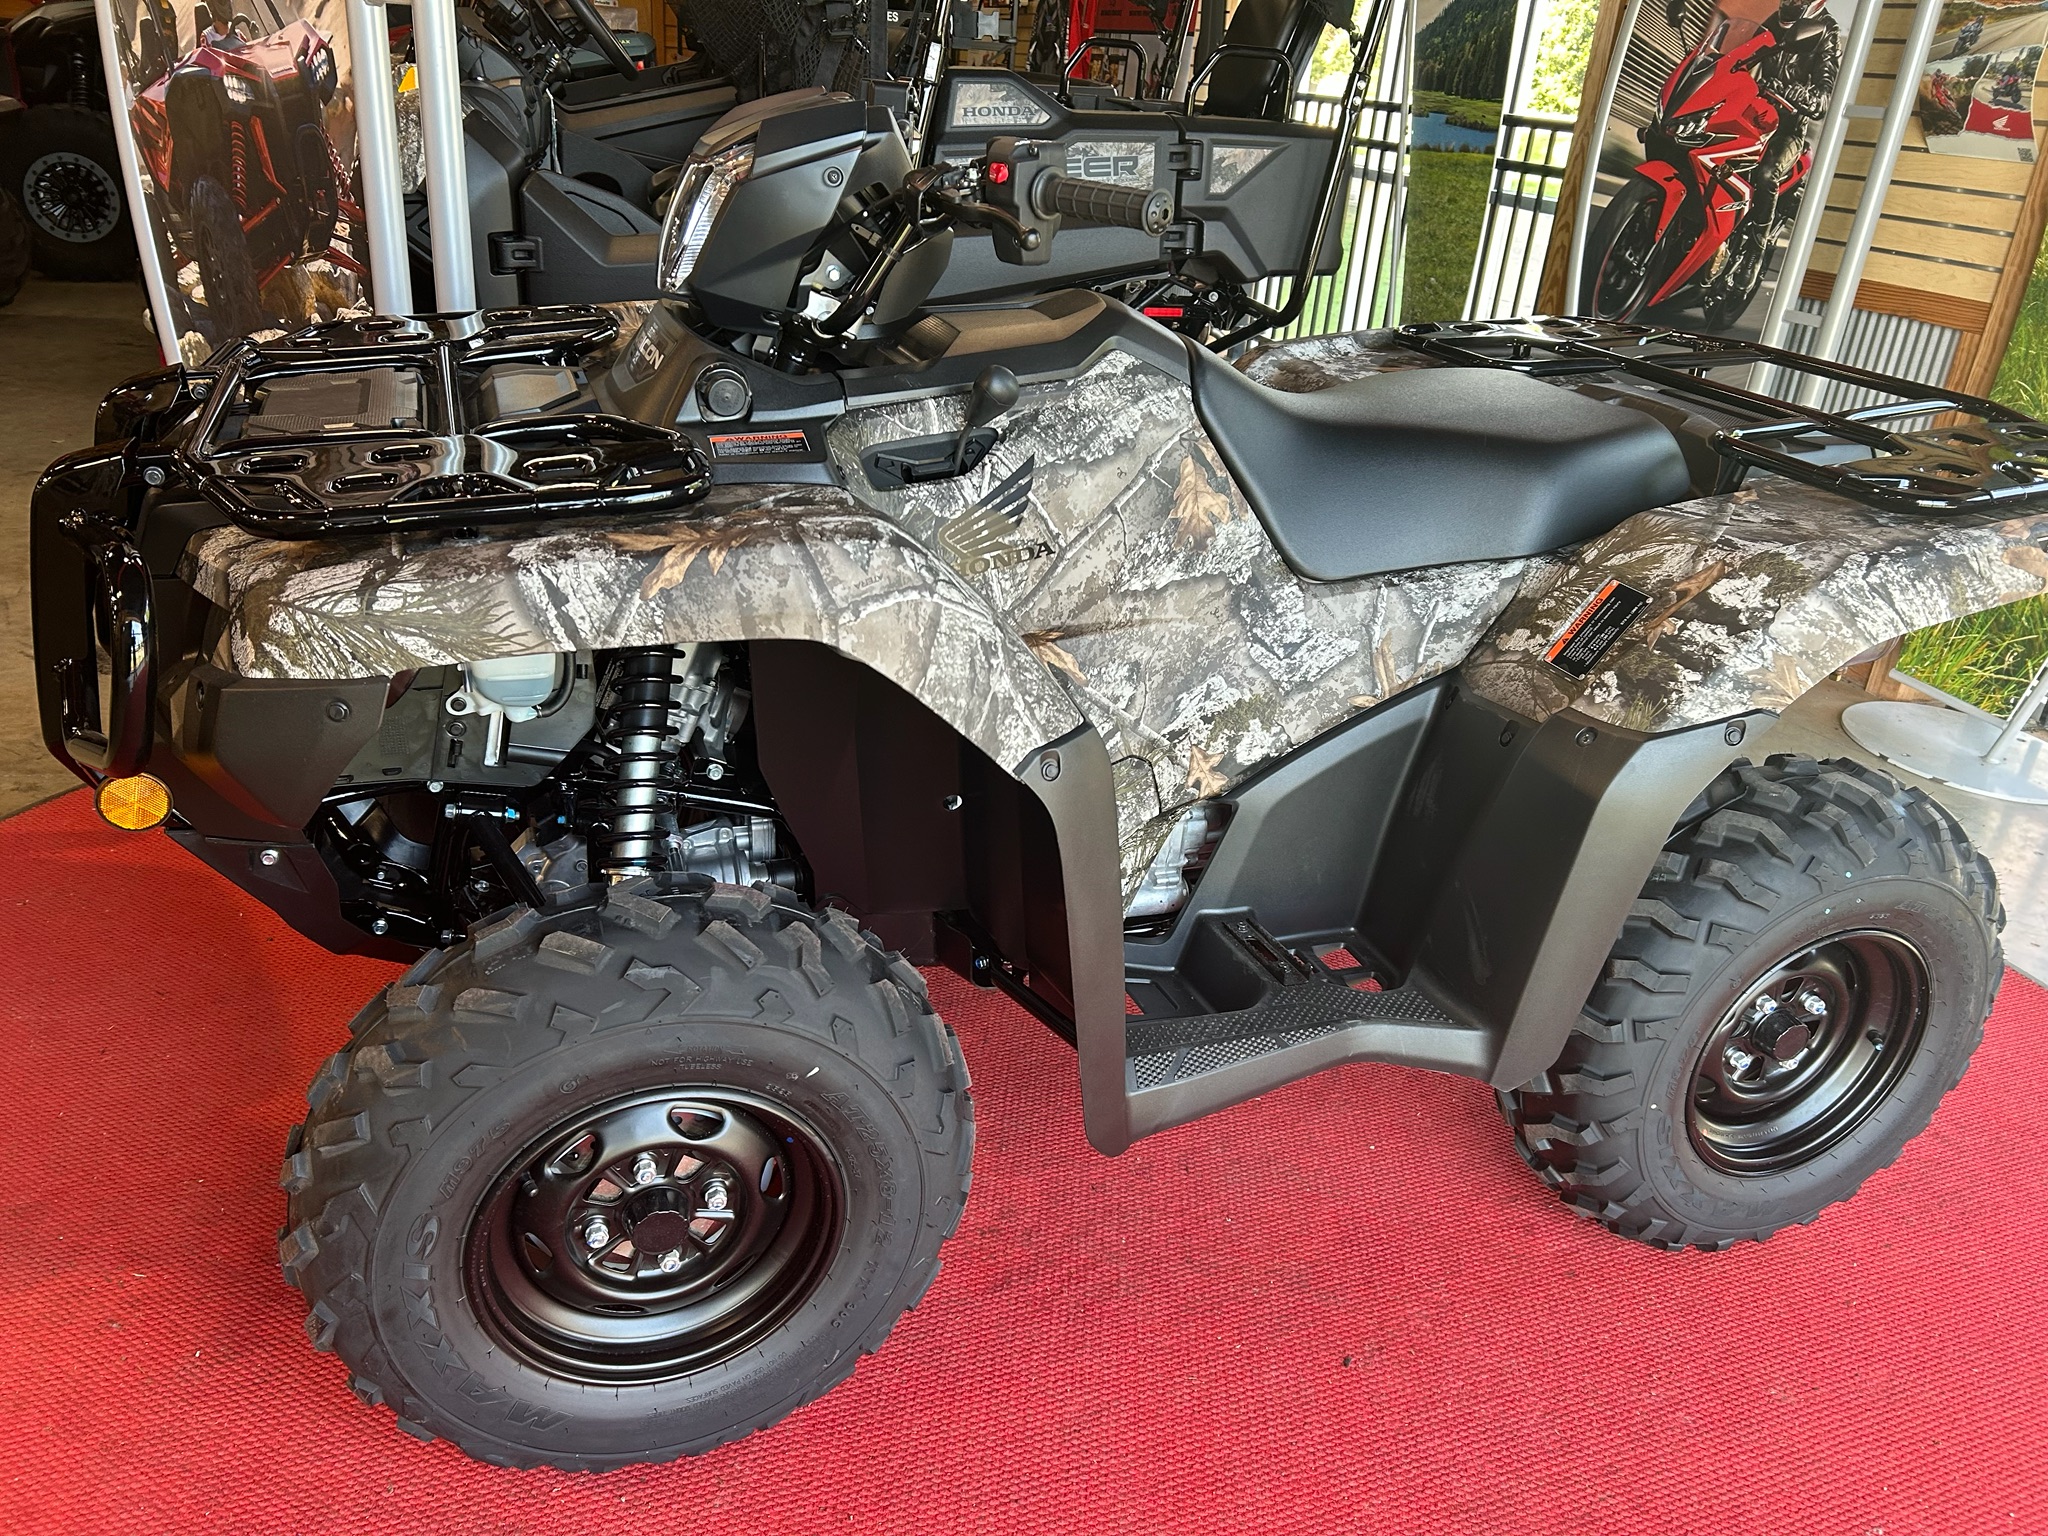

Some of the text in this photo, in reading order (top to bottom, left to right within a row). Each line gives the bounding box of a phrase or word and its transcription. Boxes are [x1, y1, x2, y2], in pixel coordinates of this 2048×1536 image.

[962, 106, 1036, 117] HONDA
[1568, 597, 1604, 636] WARNING
[651, 1055, 754, 1067] NOT FOR HIGHWAY USE
[439, 1118, 511, 1199] M975
[400, 1213, 575, 1432] MAXXIS
[751, 1366, 765, 1377] USE
[719, 1377, 742, 1391] PAVED
